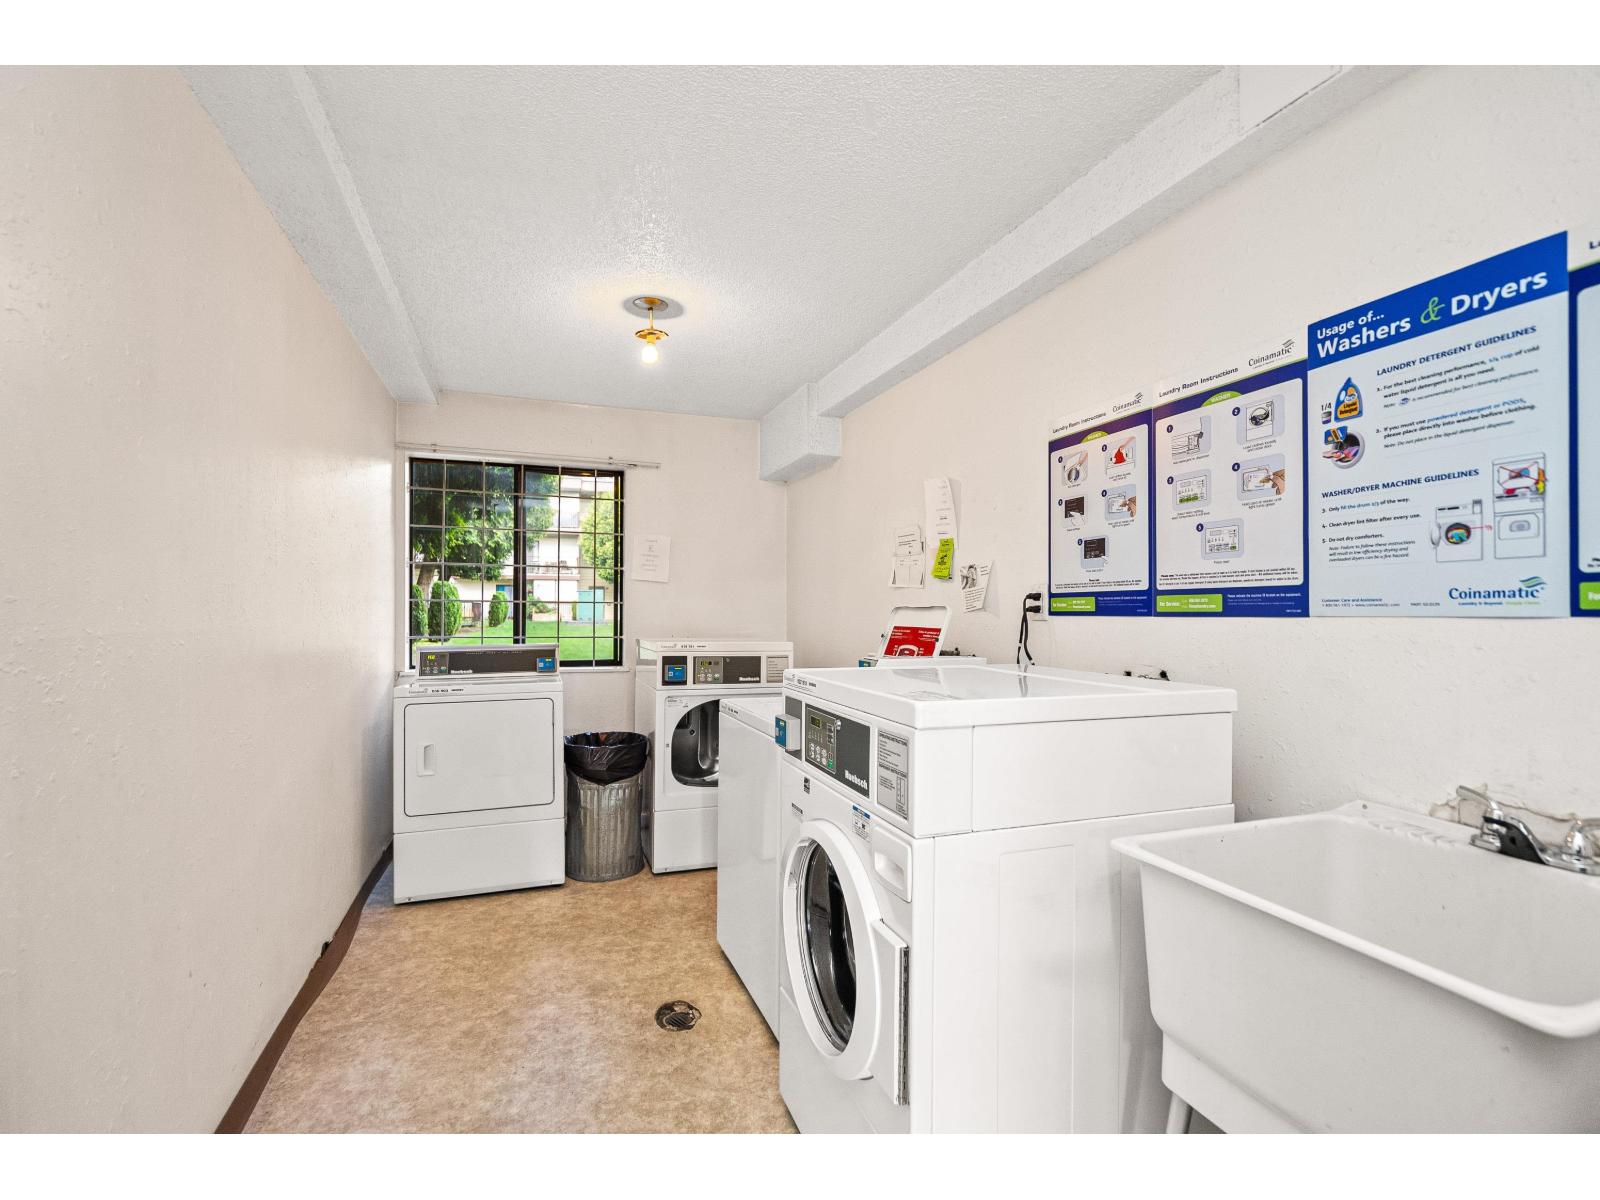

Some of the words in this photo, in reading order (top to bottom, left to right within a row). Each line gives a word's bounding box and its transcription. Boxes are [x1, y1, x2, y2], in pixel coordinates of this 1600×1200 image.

[1317, 317, 1410, 358] Washers
[1420, 293, 1445, 325] &
[1451, 271, 1547, 316] Dryers
[1317, 320, 1353, 339] Usage
[1358, 310, 1383, 326] of...
[1248, 346, 1291, 367] Coinamatic
[1376, 358, 1416, 376] LAUNDRY
[1419, 343, 1470, 364] DETERGENT
[1475, 324, 1536, 348] GUIDELINES
[1159, 386, 1180, 396] Laundry
[1182, 381, 1198, 389] Room
[1200, 367, 1238, 383] Instructions
[1400, 386, 1415, 394] liquid
[1418, 378, 1446, 390] detergent
[1404, 377, 1416, 385] best
[1418, 371, 1442, 381] cleaning
[1321, 402, 1331, 411] 1/4
[1427, 412, 1457, 423] powdered
[1459, 404, 1491, 415] detergent
[1419, 423, 1440, 431] directly
[1322, 483, 1379, 498] WASHER/DRYER
[1382, 477, 1421, 489] MACHINE
[1425, 468, 1479, 483] GUIDELINES
[1448, 585, 1539, 599] Coinamatic
[845, 769, 869, 790] Huebsch
